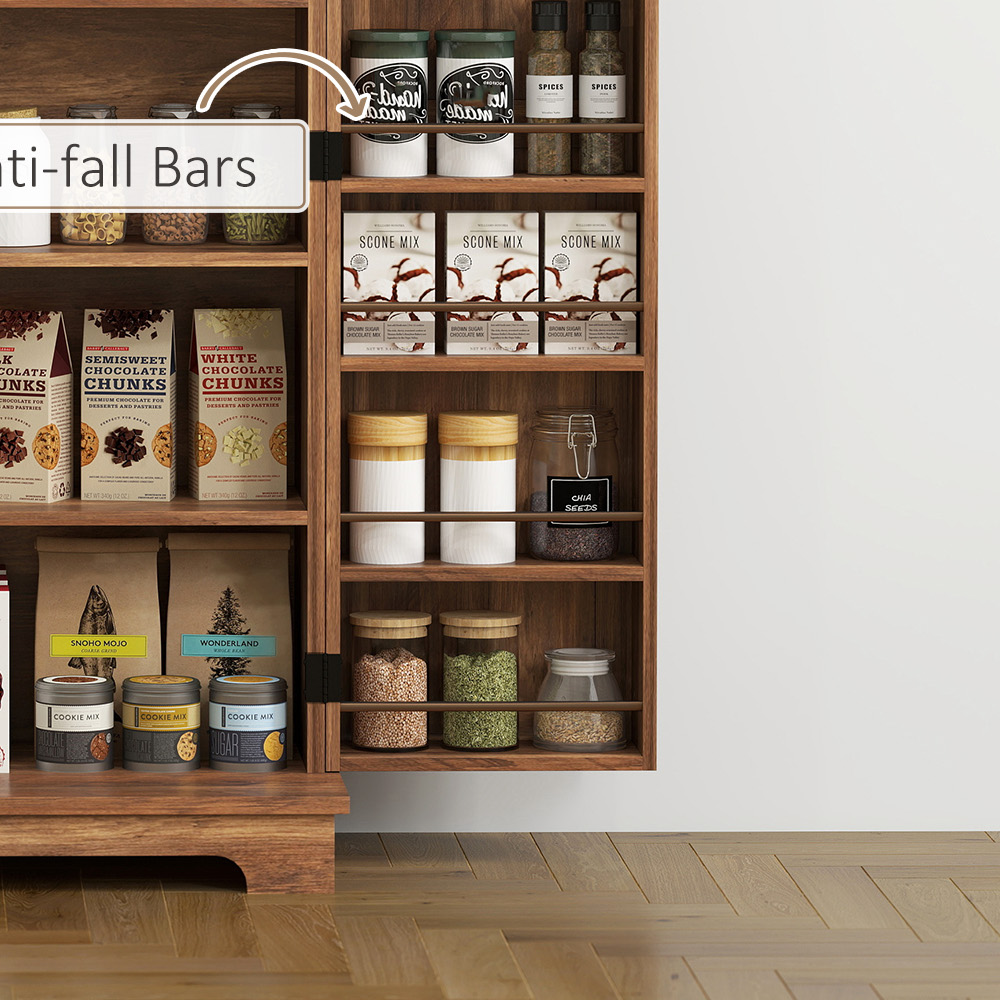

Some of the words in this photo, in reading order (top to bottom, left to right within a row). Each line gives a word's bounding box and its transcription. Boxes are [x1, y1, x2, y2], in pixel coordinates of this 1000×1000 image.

[359, 235, 395, 249] SCONE
[400, 235, 420, 249] MIX
[463, 235, 499, 249] SCONE
[504, 235, 523, 249] MIX
[561, 235, 596, 248] SCONE
[602, 235, 621, 248] MIX
[85, 356, 167, 365] SEMISWEET
[200, 354, 258, 364] WHITE
[85, 367, 167, 376] CHOCOLATE
[202, 366, 284, 374] CHOCOLATE
[84, 378, 166, 390] CHUNKS
[202, 377, 284, 390] CHUNKS
[571, 494, 592, 502] CHIA
[565, 504, 598, 512] SEEDS
